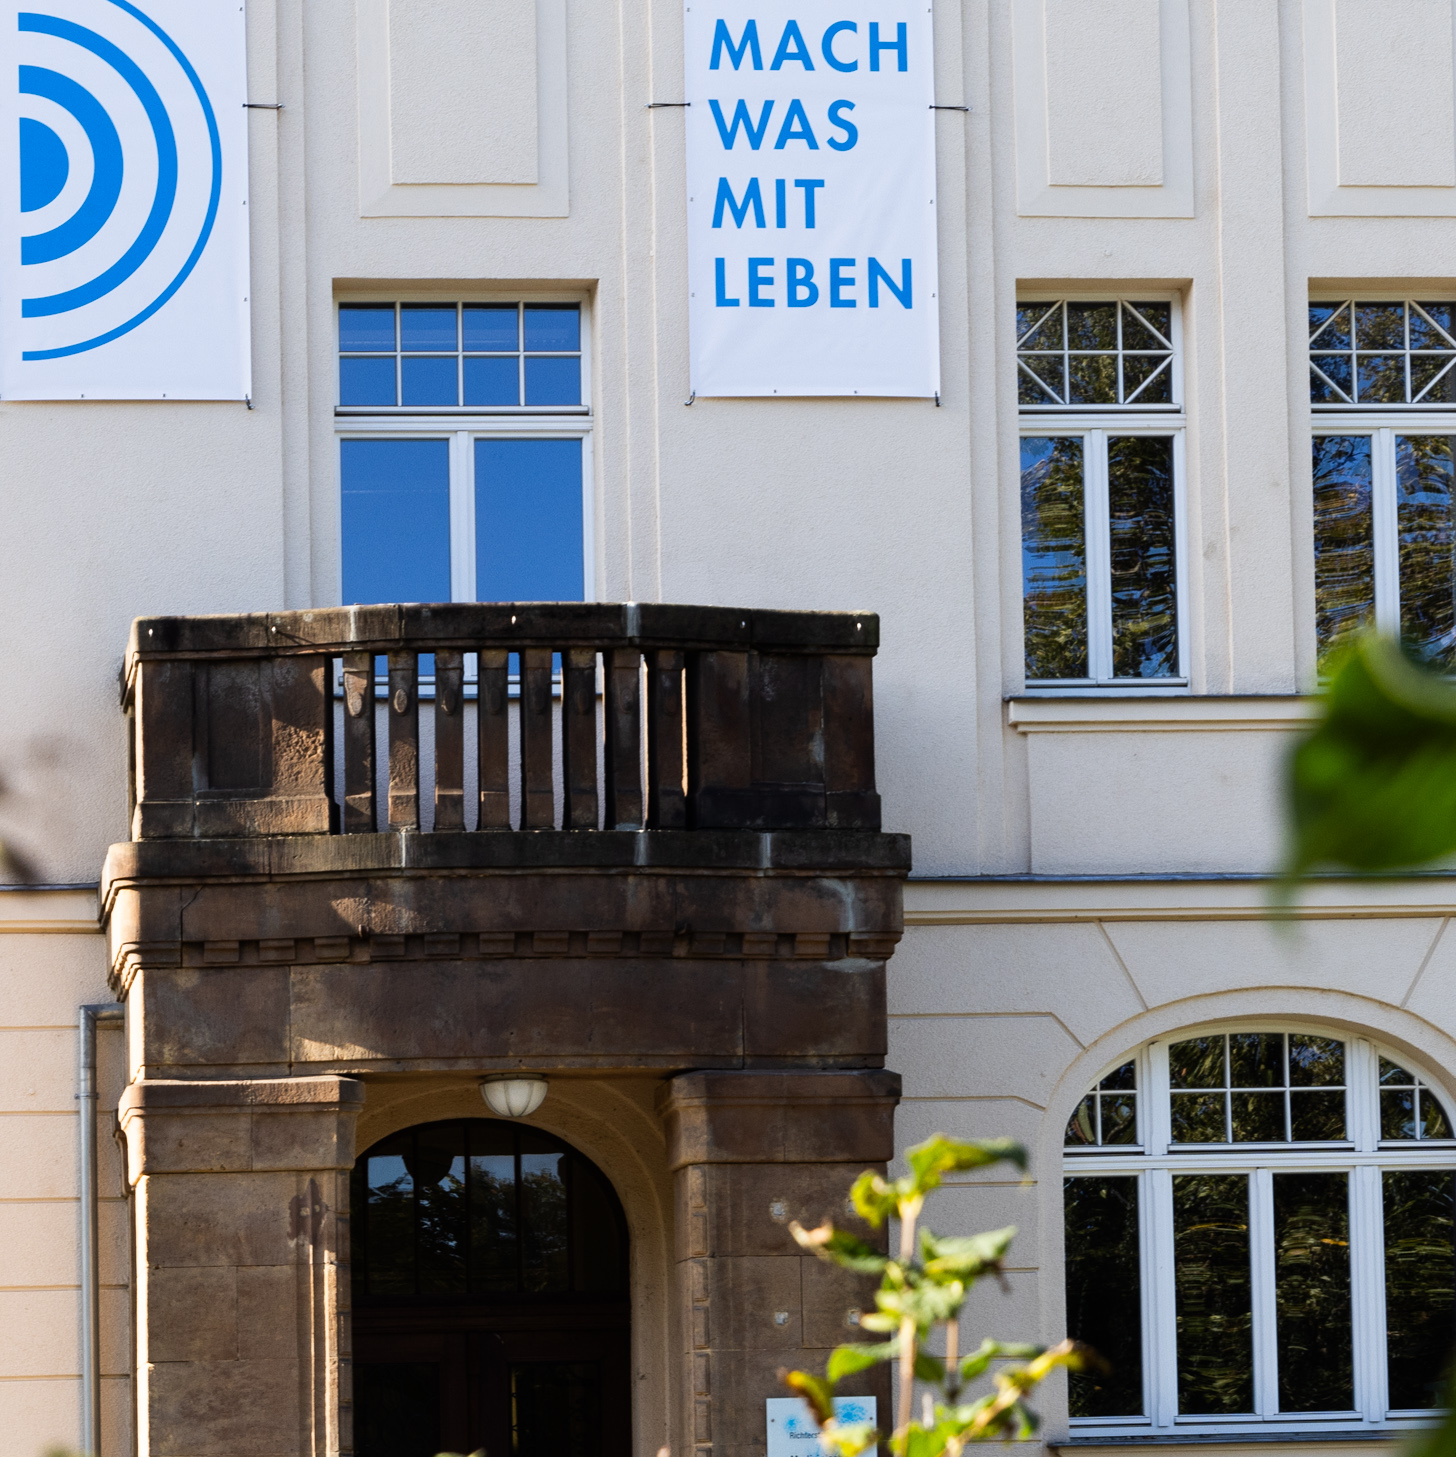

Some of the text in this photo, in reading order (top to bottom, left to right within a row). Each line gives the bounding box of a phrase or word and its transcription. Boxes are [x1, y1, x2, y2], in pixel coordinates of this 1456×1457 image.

[708, 18, 909, 73] MACH
[707, 98, 859, 152] WAS
[711, 176, 826, 229] MIT
[714, 256, 913, 310] LEBEN
